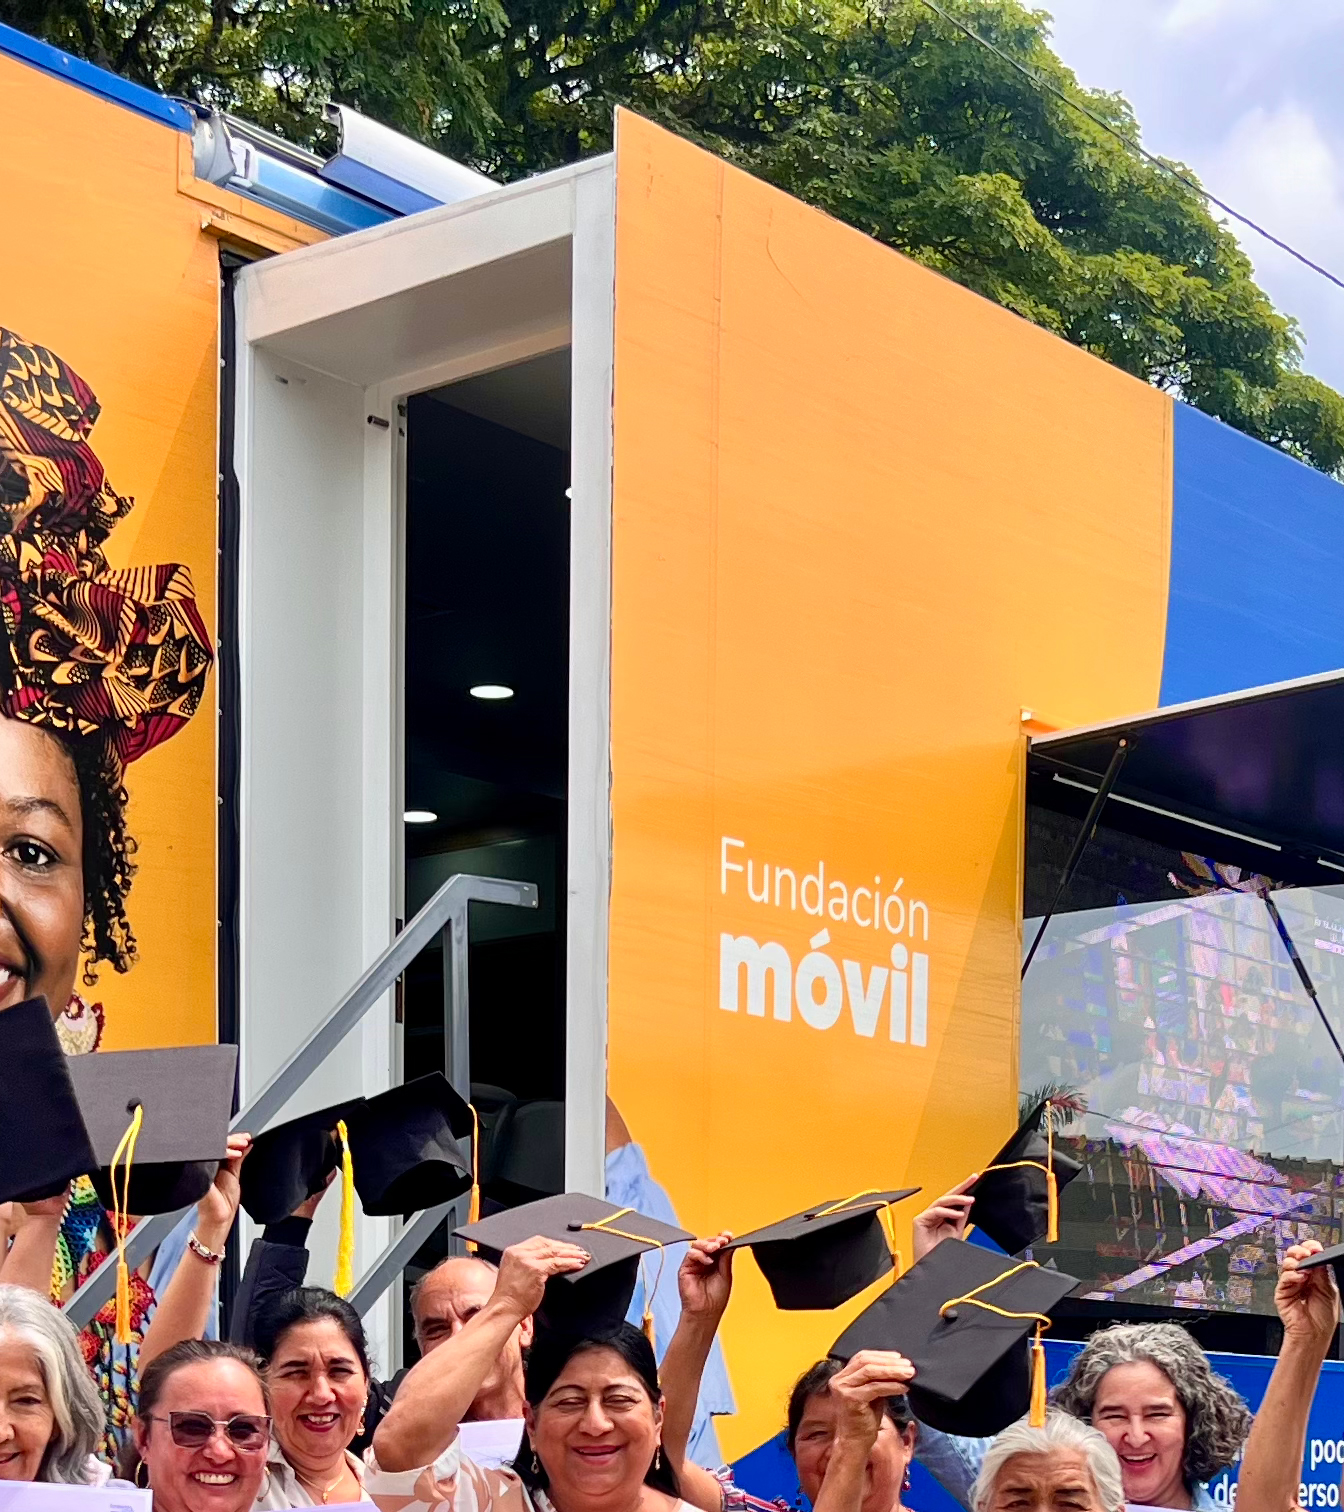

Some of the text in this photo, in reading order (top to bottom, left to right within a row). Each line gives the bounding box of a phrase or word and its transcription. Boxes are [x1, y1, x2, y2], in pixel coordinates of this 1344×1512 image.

[720, 836, 929, 941] Fundación
[719, 928, 929, 1047] móvil
[1297, 1482, 1339, 1507] erso
